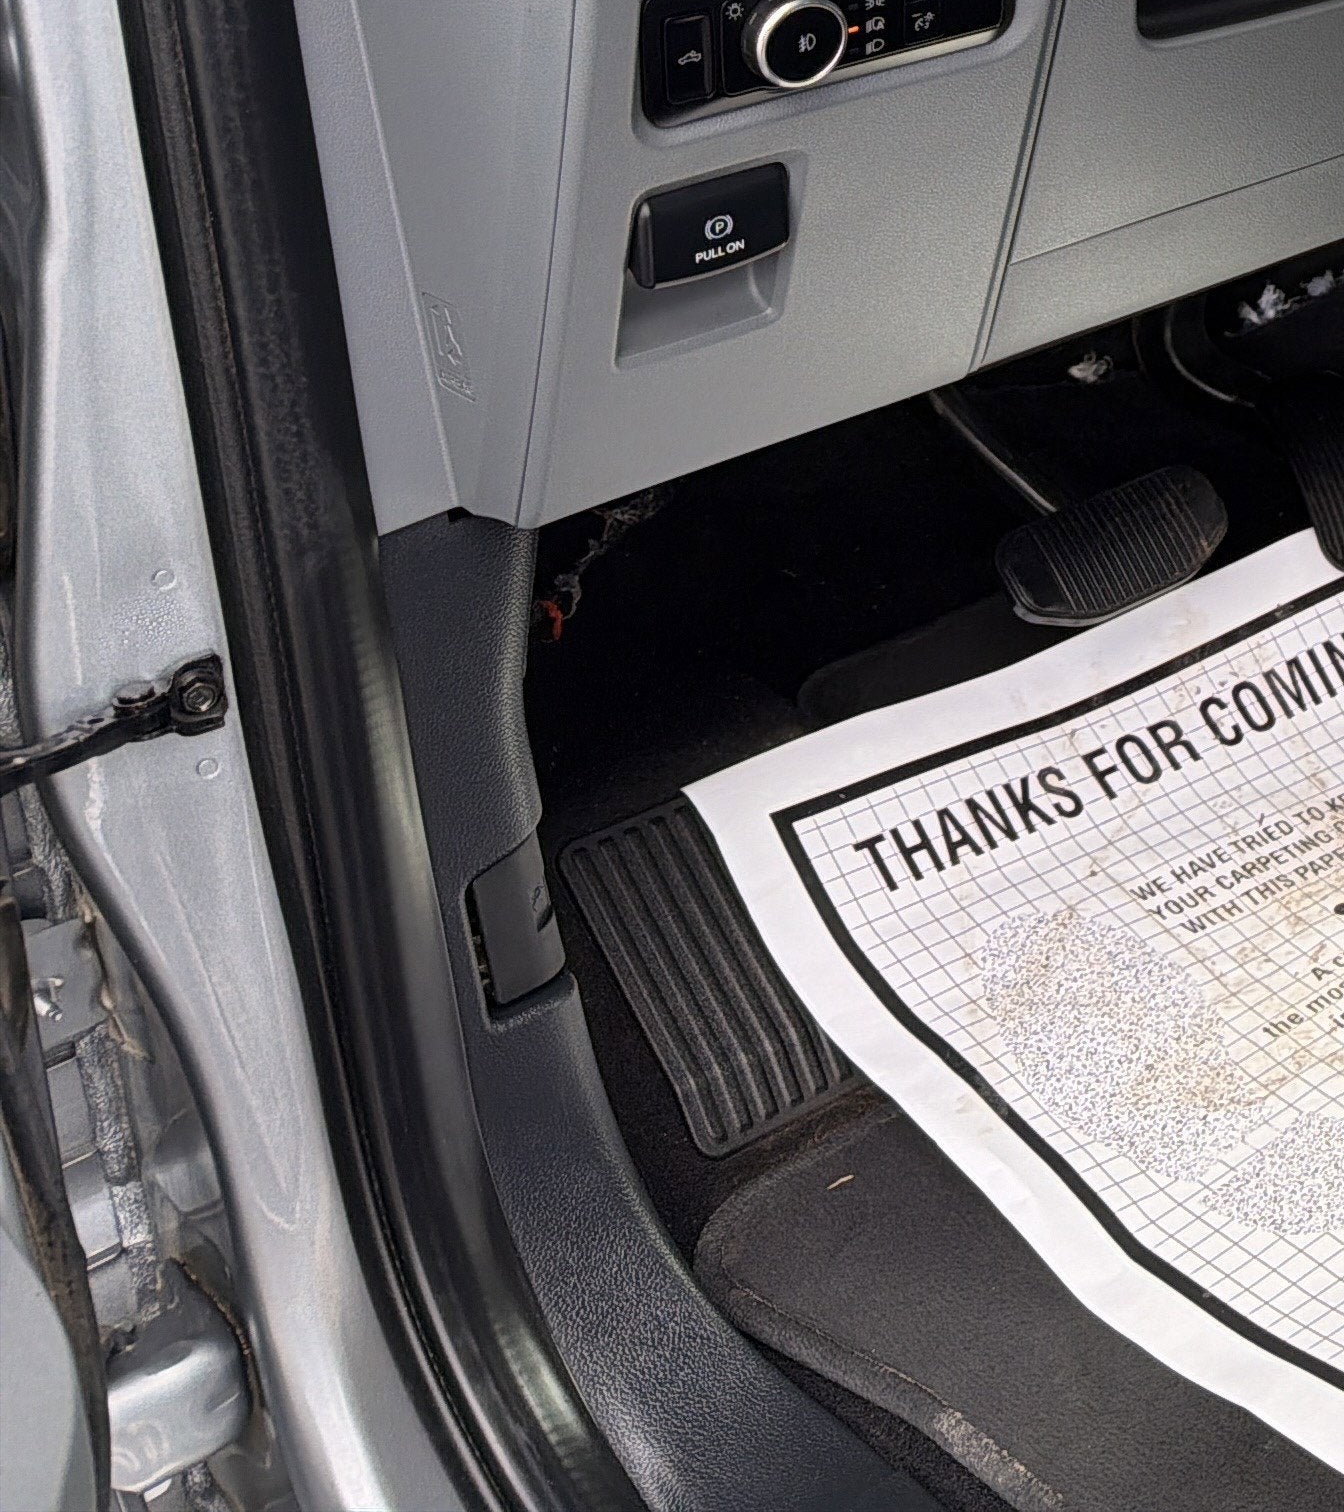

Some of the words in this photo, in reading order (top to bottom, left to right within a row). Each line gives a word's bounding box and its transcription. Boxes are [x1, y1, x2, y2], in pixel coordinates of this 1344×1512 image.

[695, 245, 726, 264] PULL
[726, 238, 745, 254] ON
[854, 765, 1084, 893] THANKS
[1082, 719, 1200, 801] FOR
[1130, 875, 1173, 902] WE
[1170, 846, 1232, 885] HAVE
[1228, 820, 1294, 855] TRIED
[1293, 806, 1325, 827] TO
[1149, 885, 1217, 921] YOUR
[1215, 829, 1333, 891] CARPETING
[1179, 899, 1245, 935] WITH
[1240, 873, 1296, 906] THIS
[1310, 966, 1334, 982] A
[1262, 1012, 1305, 1038] the
